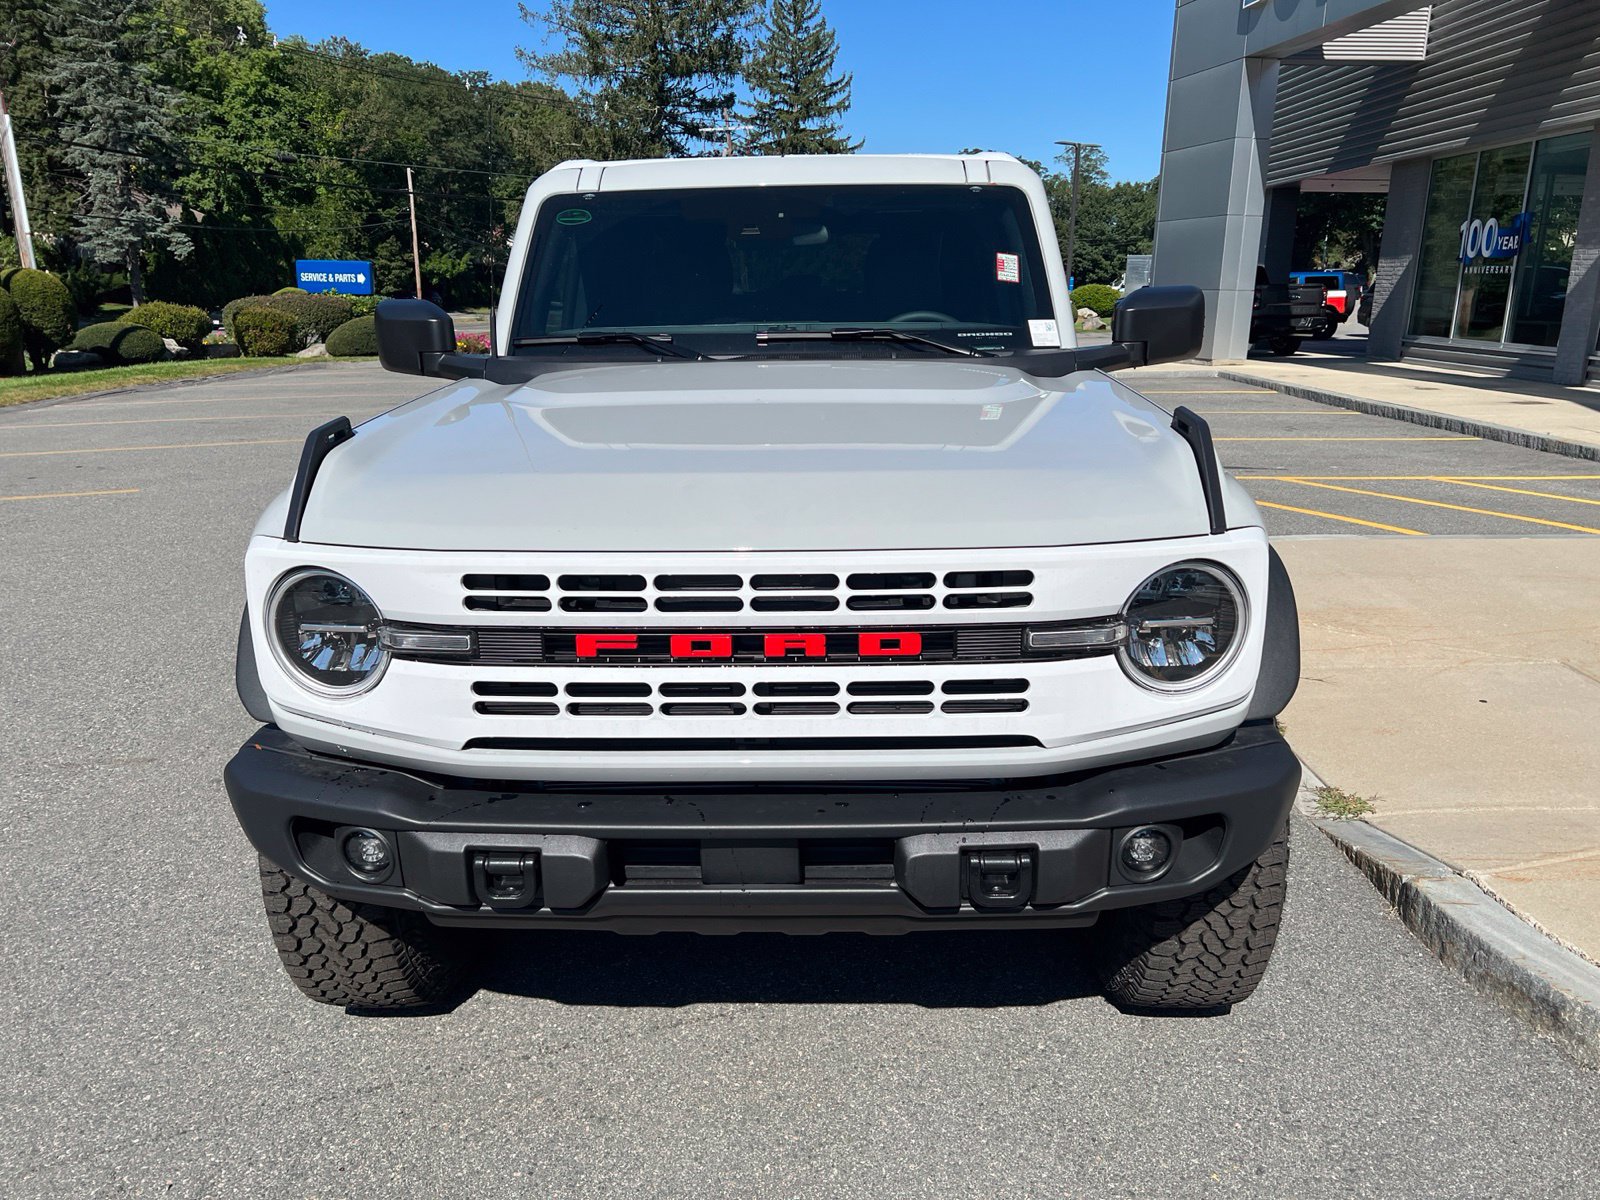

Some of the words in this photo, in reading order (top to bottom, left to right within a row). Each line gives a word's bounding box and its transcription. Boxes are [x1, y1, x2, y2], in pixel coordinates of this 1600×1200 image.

[1460, 218, 1498, 258] 100
[300, 272, 327, 282] SERVICE
[328, 273, 334, 283] &
[335, 273, 356, 283] PARTS
[575, 632, 922, 658] FORD
